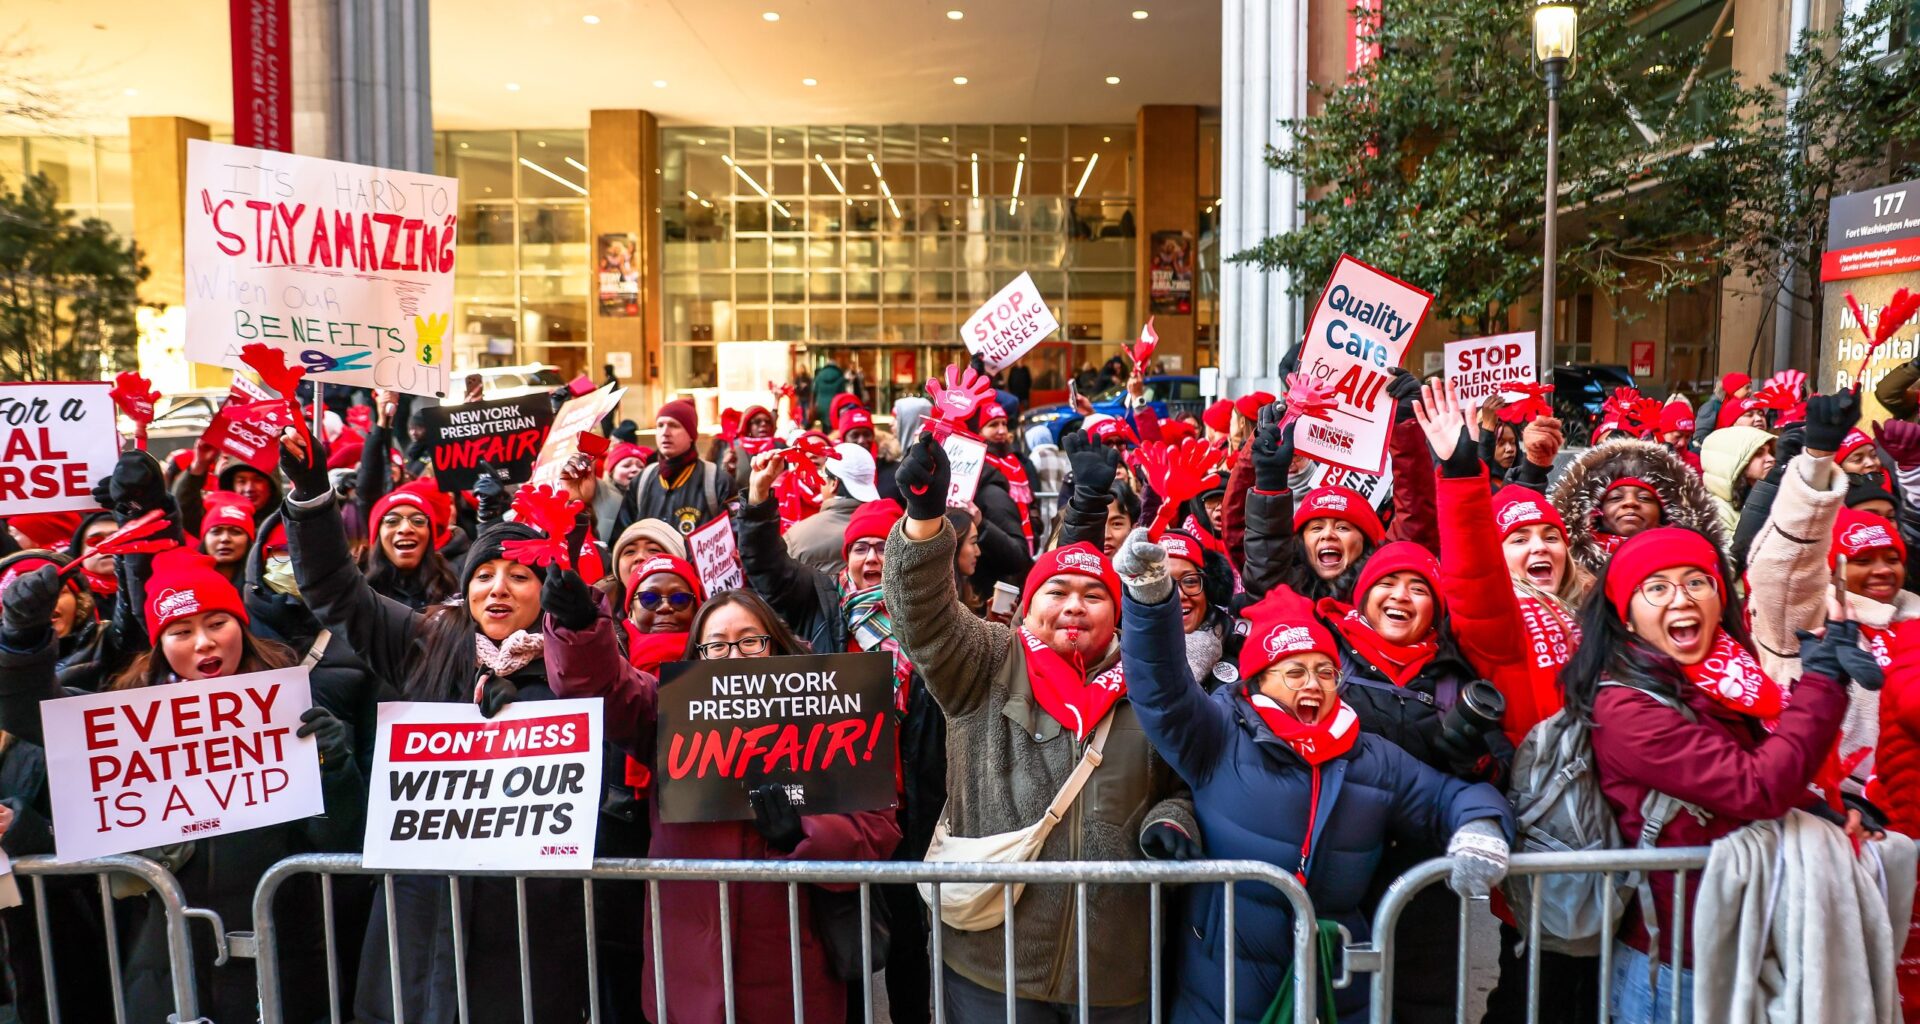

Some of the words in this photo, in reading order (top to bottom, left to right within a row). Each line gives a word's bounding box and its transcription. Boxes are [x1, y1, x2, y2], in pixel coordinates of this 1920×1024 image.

[223, 164, 295, 198] ITS
[333, 172, 407, 212] HARD
[410, 182, 449, 217] TO
[1873, 190, 1907, 218] 177
[1845, 228, 1860, 239] Fort
[1860, 220, 1903, 236] Washington
[1893, 256, 1911, 264] Medical
[974, 291, 1023, 342] STOP
[1328, 284, 1412, 342] Quality
[234, 309, 406, 353] BENEFITS
[989, 321, 1039, 363] NURSES
[1326, 319, 1388, 368] Care
[1458, 343, 1522, 372] STOP
[1310, 357, 1339, 382] for
[1334, 364, 1388, 413] All
[1450, 365, 1531, 388] SILENCING
[59, 398, 87, 421] a
[449, 409, 481, 425] NEW
[482, 404, 521, 420] YORK
[440, 416, 536, 439] PRESBYTERIAN
[1308, 423, 1355, 449] NURSES
[1306, 436, 1353, 456] ASSOCIATION
[712, 673, 767, 696] NEW
[769, 670, 838, 693] YORK
[83, 683, 281, 750] EVERY
[688, 693, 861, 721] PRESBYTERIAN
[404, 729, 500, 755] DON'T
[502, 722, 577, 752] MESS
[667, 712, 885, 780] UNFAIR!
[89, 727, 290, 792] PATIENT
[389, 768, 494, 801] WITH
[502, 762, 585, 798] OUR
[94, 791, 147, 833] IS
[161, 784, 195, 821] A
[205, 767, 289, 811] VIP
[181, 819, 221, 834] NURSES
[390, 802, 574, 841] BENEFITS
[540, 845, 579, 856] NURSES
